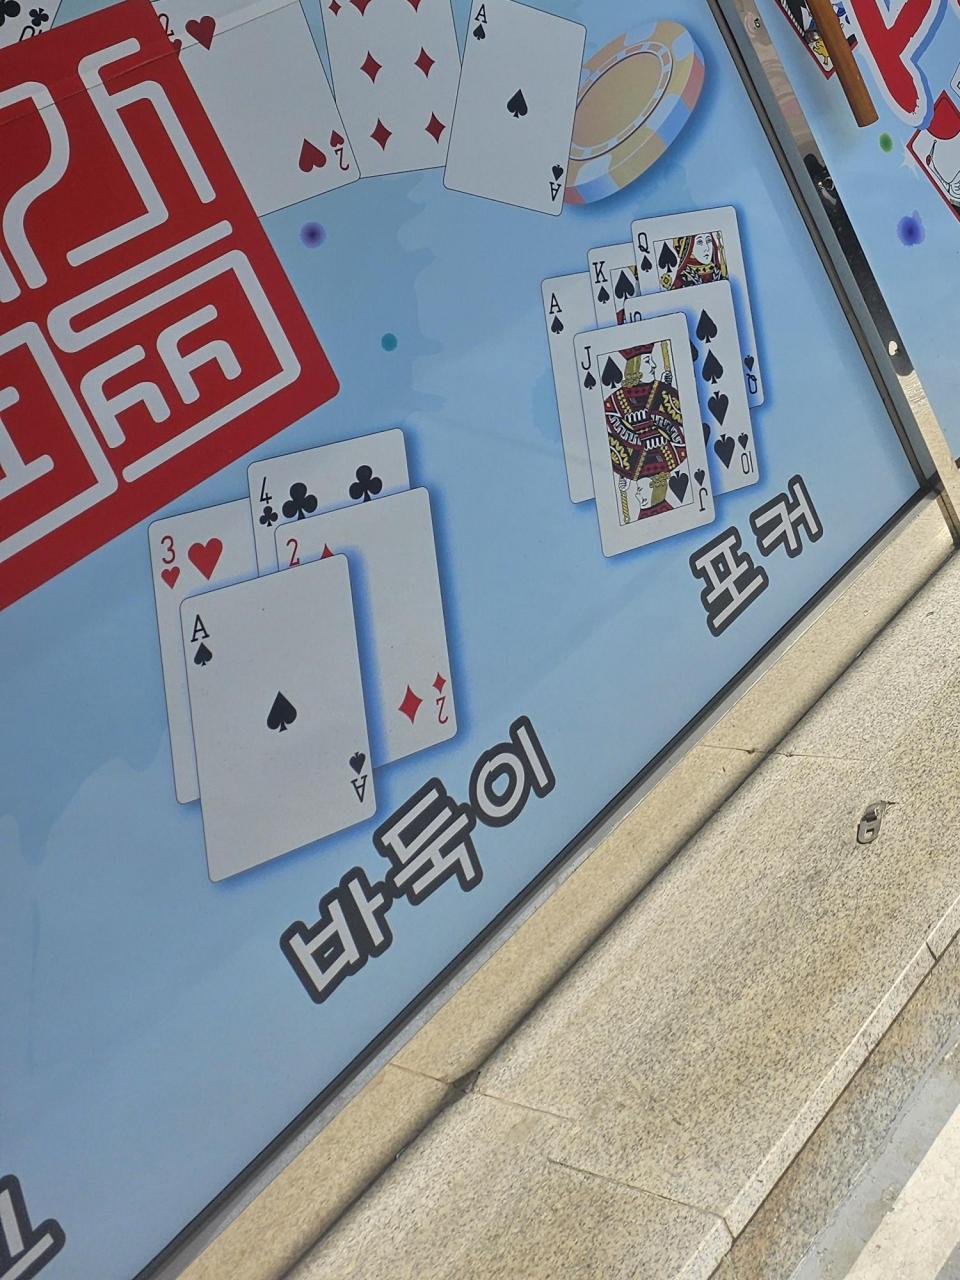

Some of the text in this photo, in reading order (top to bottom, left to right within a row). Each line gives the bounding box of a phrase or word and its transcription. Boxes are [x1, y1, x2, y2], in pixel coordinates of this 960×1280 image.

[474, 3, 488, 24] A
[548, 181, 562, 202] A
[637, 232, 651, 254] Q
[592, 261, 608, 284] K
[549, 292, 563, 315] A
[581, 346, 592, 371] J
[740, 452, 754, 475] 10
[258, 476, 273, 504] 4
[160, 535, 176, 564] 3
[691, 476, 821, 634] 포커
[190, 614, 210, 642] A
[350, 774, 368, 803] A
[283, 718, 553, 1000] 바둑이
